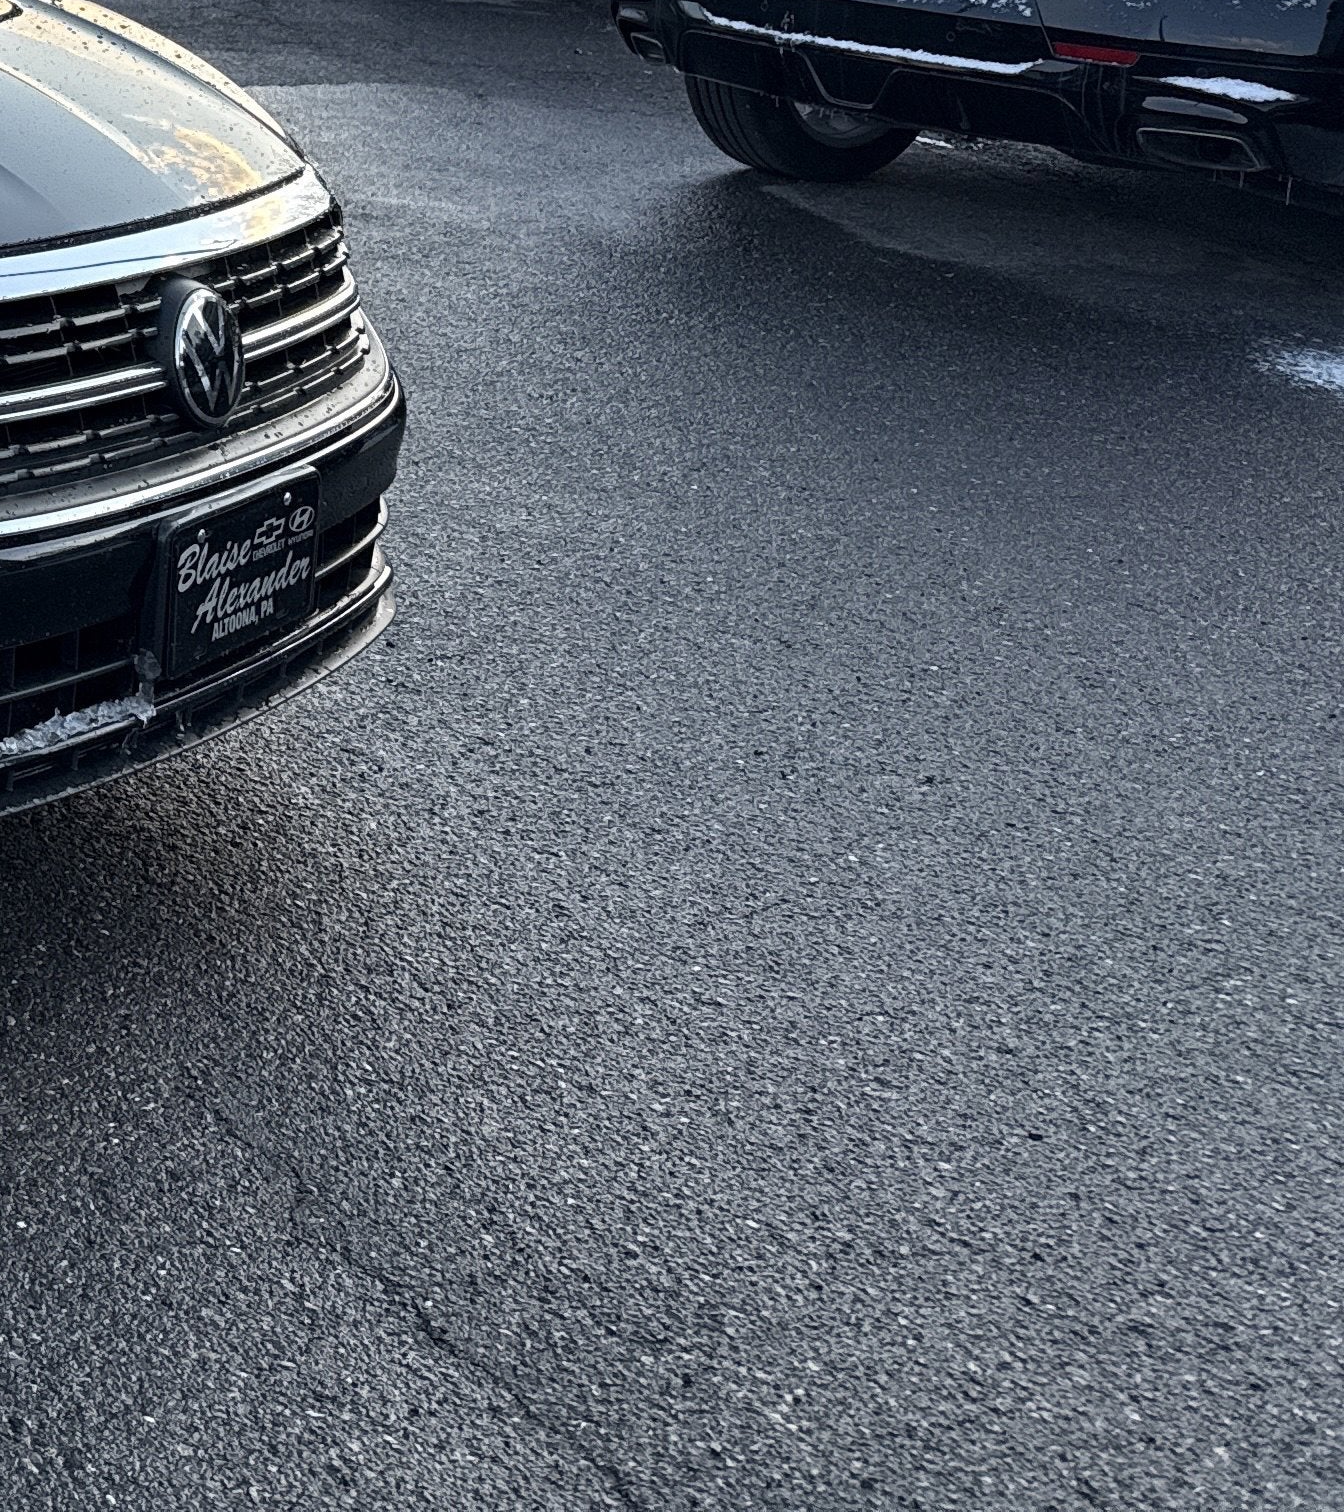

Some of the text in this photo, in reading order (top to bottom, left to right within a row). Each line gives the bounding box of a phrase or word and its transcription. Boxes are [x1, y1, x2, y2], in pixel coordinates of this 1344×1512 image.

[177, 538, 252, 593] Blaise
[253, 538, 285, 561] CHEVROLET
[190, 550, 312, 635] Alexander
[212, 598, 274, 642] ALTOONA, PA
